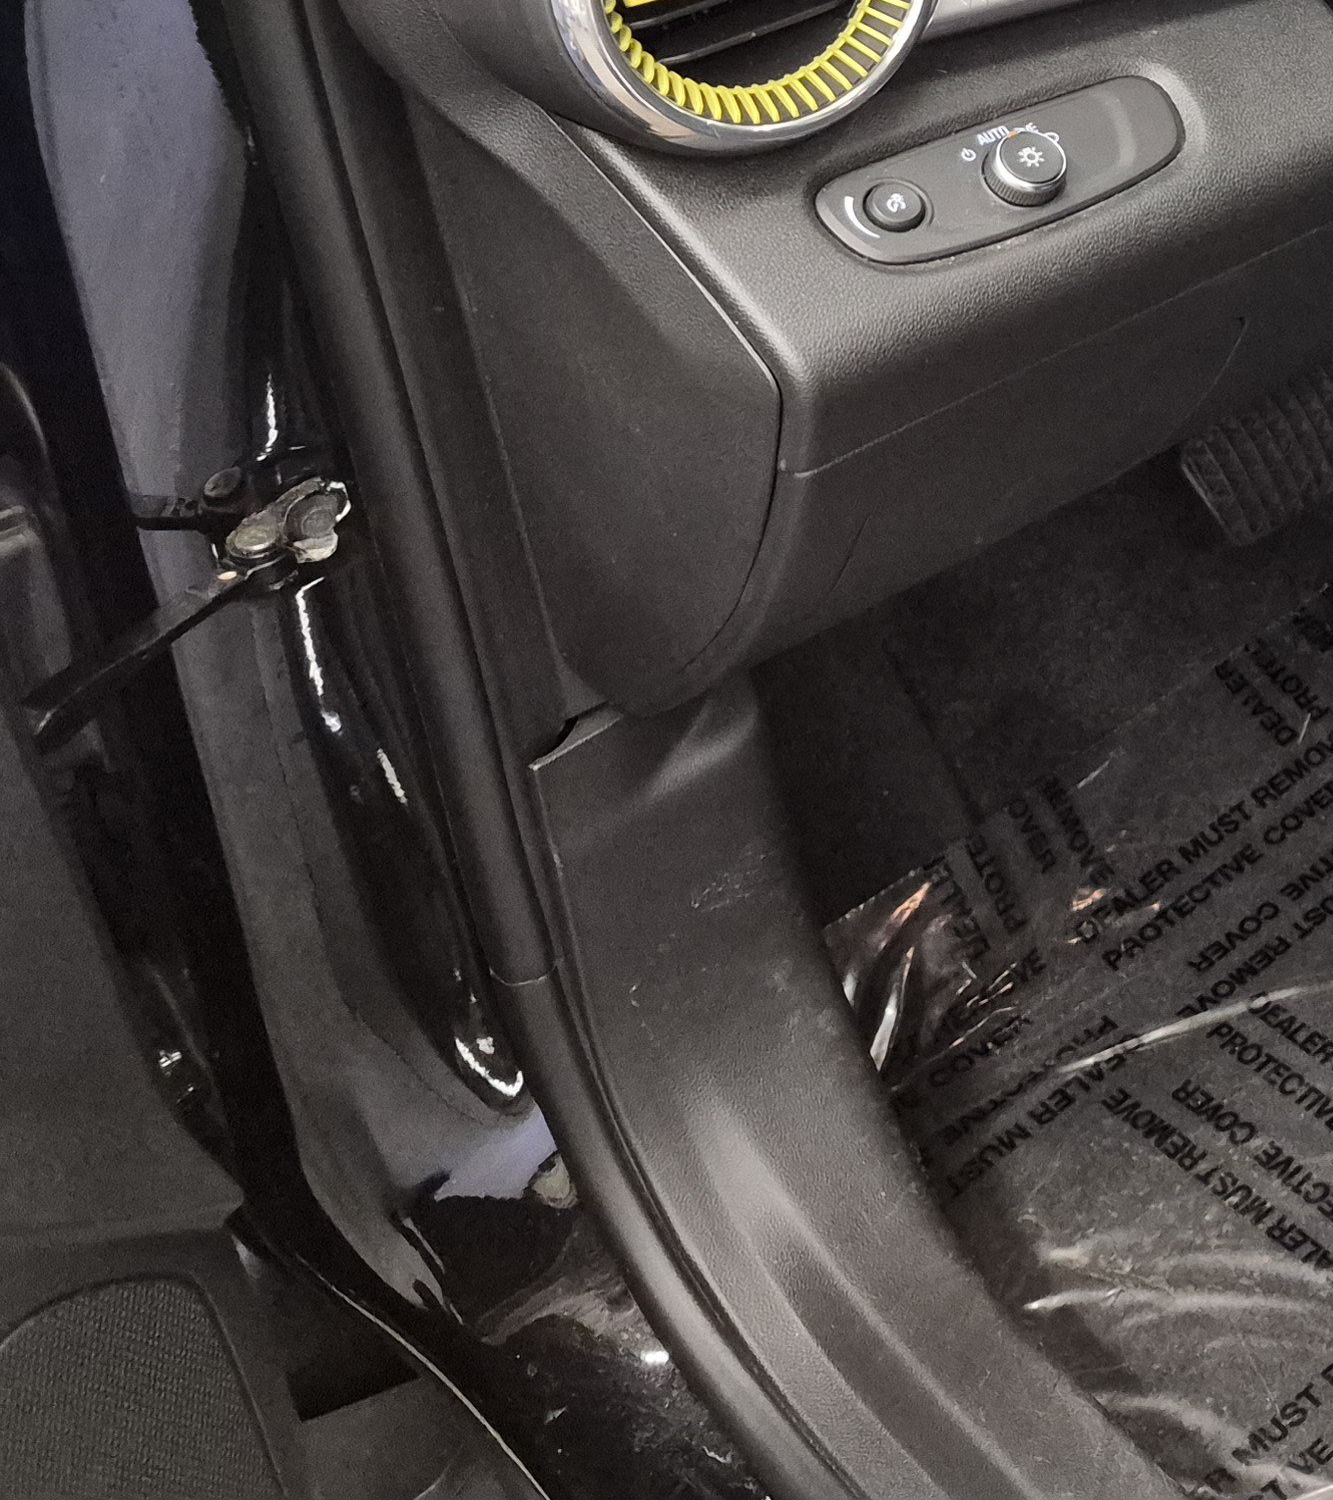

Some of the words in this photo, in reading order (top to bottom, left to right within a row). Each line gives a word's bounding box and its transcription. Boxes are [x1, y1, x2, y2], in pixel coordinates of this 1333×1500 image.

[977, 125, 1010, 146] AUTO
[1178, 800, 1253, 864] MUST
[1101, 843, 1264, 972] PROTECTIVE
[1188, 901, 1280, 973] COVER
[1101, 1086, 1209, 1173] REMOVE
[1171, 1078, 1257, 1146] COVER
[1197, 1164, 1275, 1227] MUST
